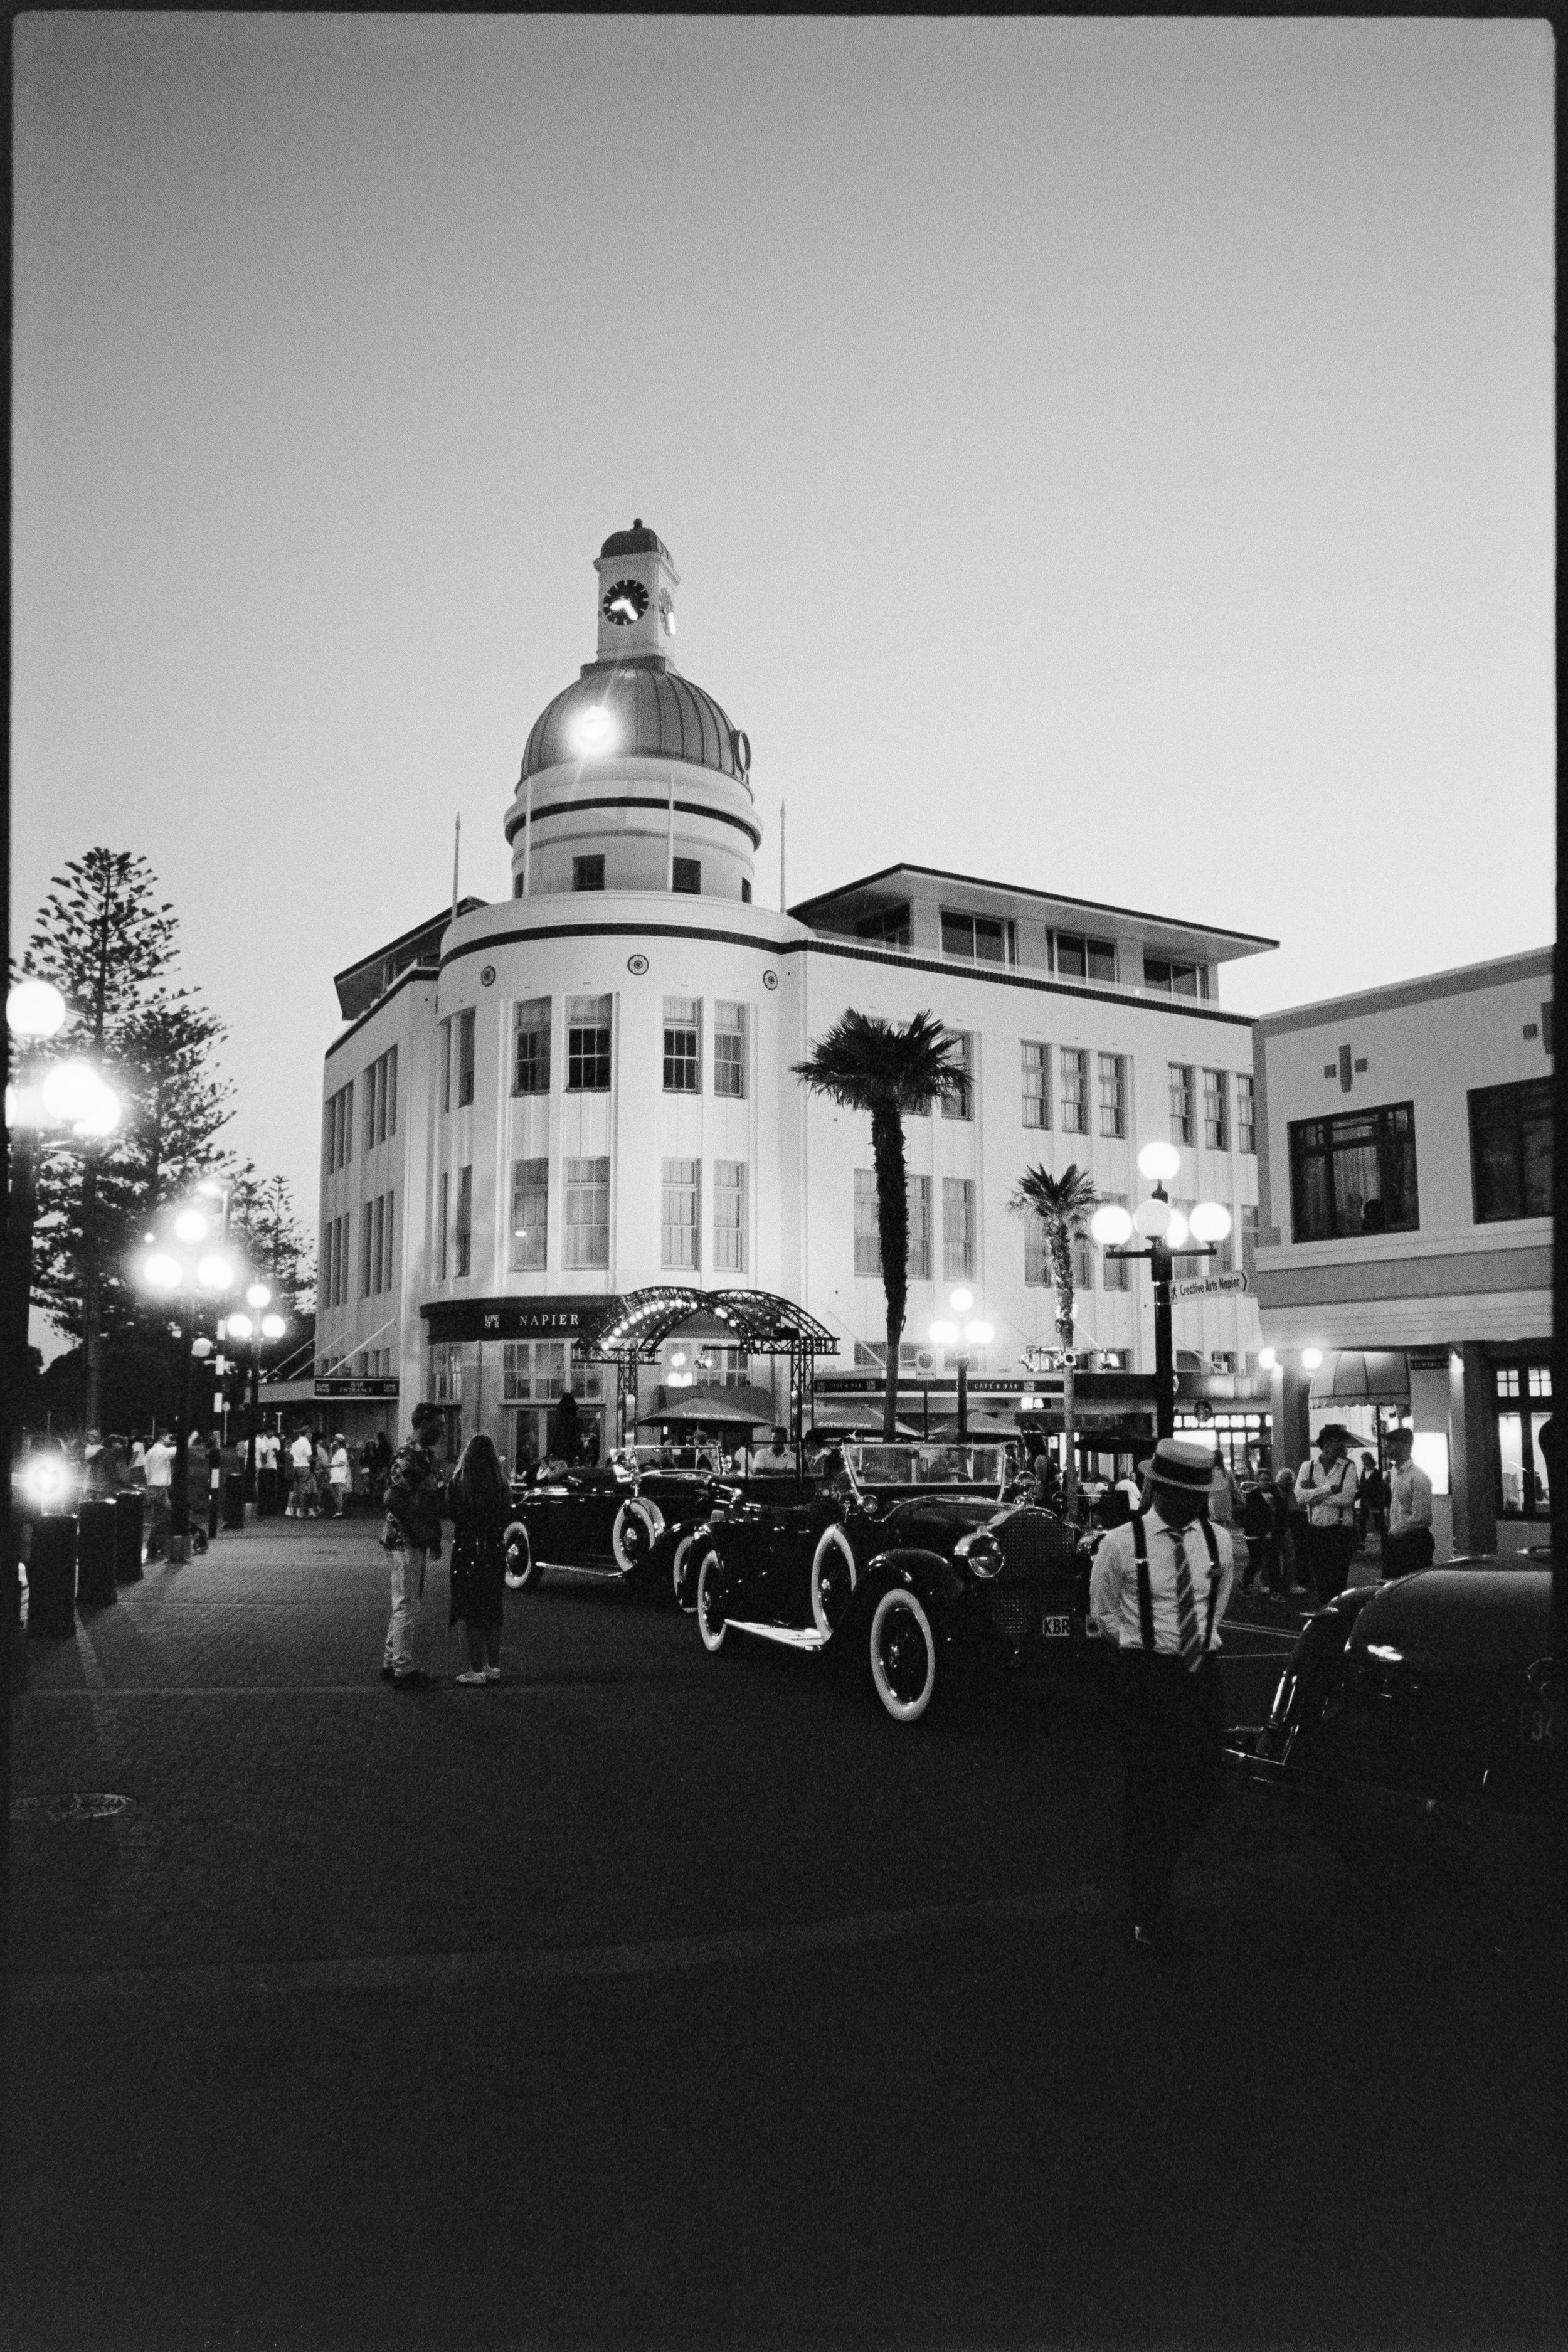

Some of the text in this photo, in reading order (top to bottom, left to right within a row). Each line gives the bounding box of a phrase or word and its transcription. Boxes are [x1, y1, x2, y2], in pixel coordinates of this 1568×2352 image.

[1180, 1276, 1240, 1296] Creative Arts Napier
[519, 1314, 579, 1325] NAPIER
[1044, 1619, 1069, 1634] KBR
